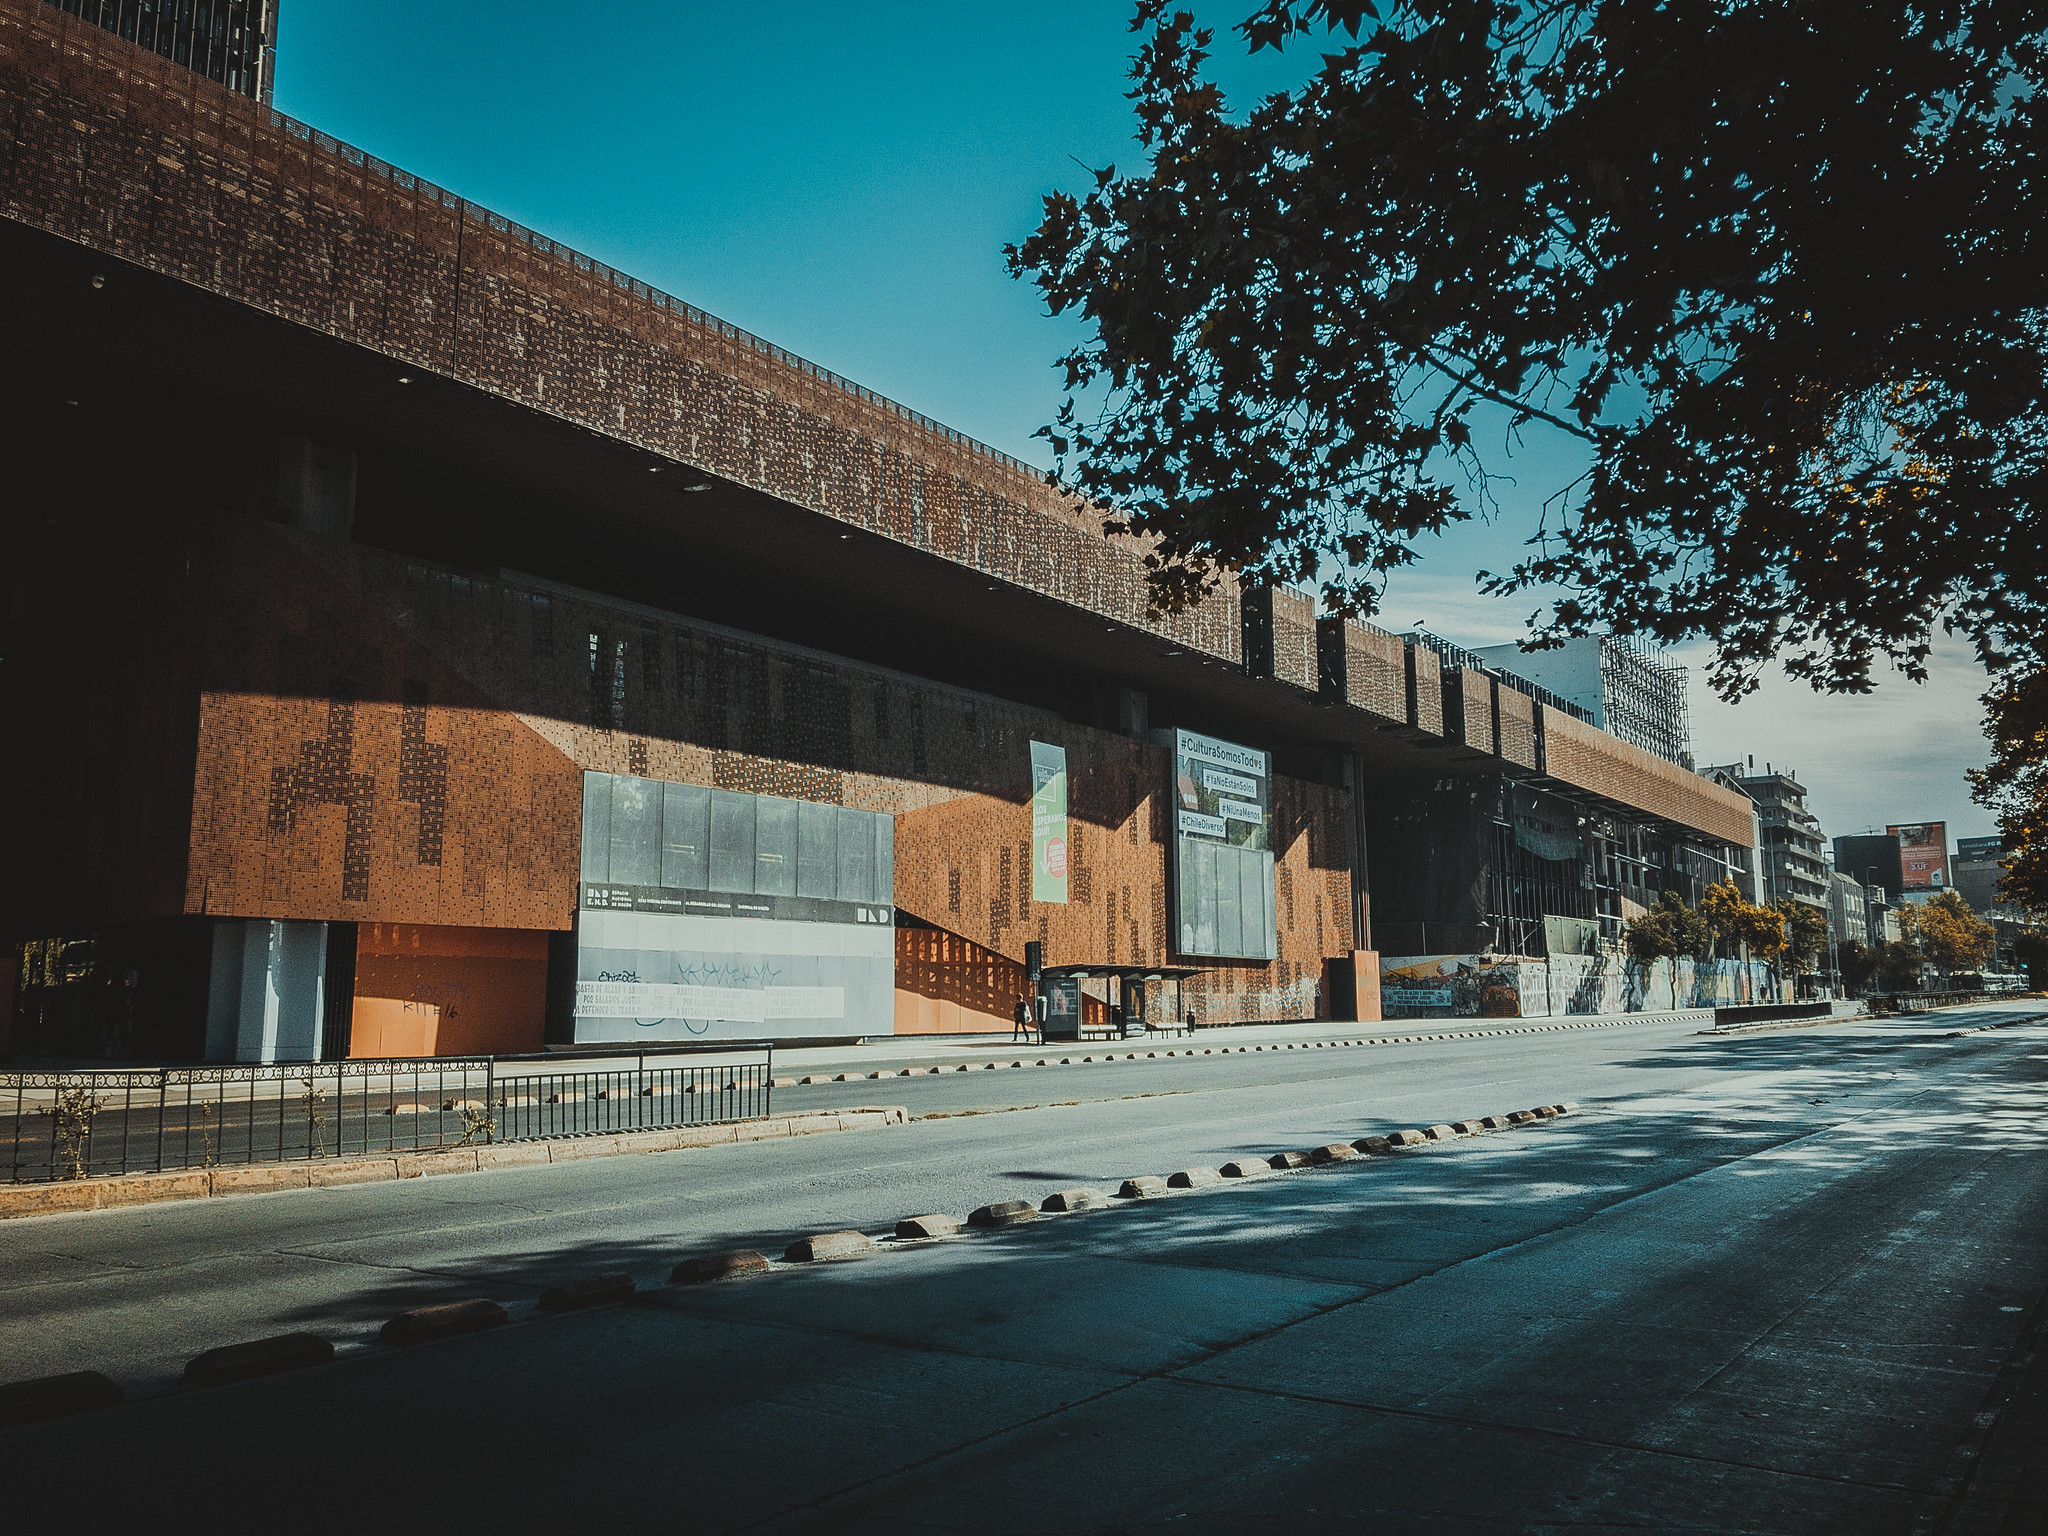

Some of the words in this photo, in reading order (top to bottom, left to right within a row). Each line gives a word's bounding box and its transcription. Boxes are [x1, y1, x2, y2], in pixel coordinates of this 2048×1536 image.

[1034, 812, 1067, 827] ESPERAMOS
[1222, 804, 1261, 821] #NiUnaMenos
[1182, 816, 1224, 833] #ChileDiverso
[576, 984, 595, 993] BASTA
